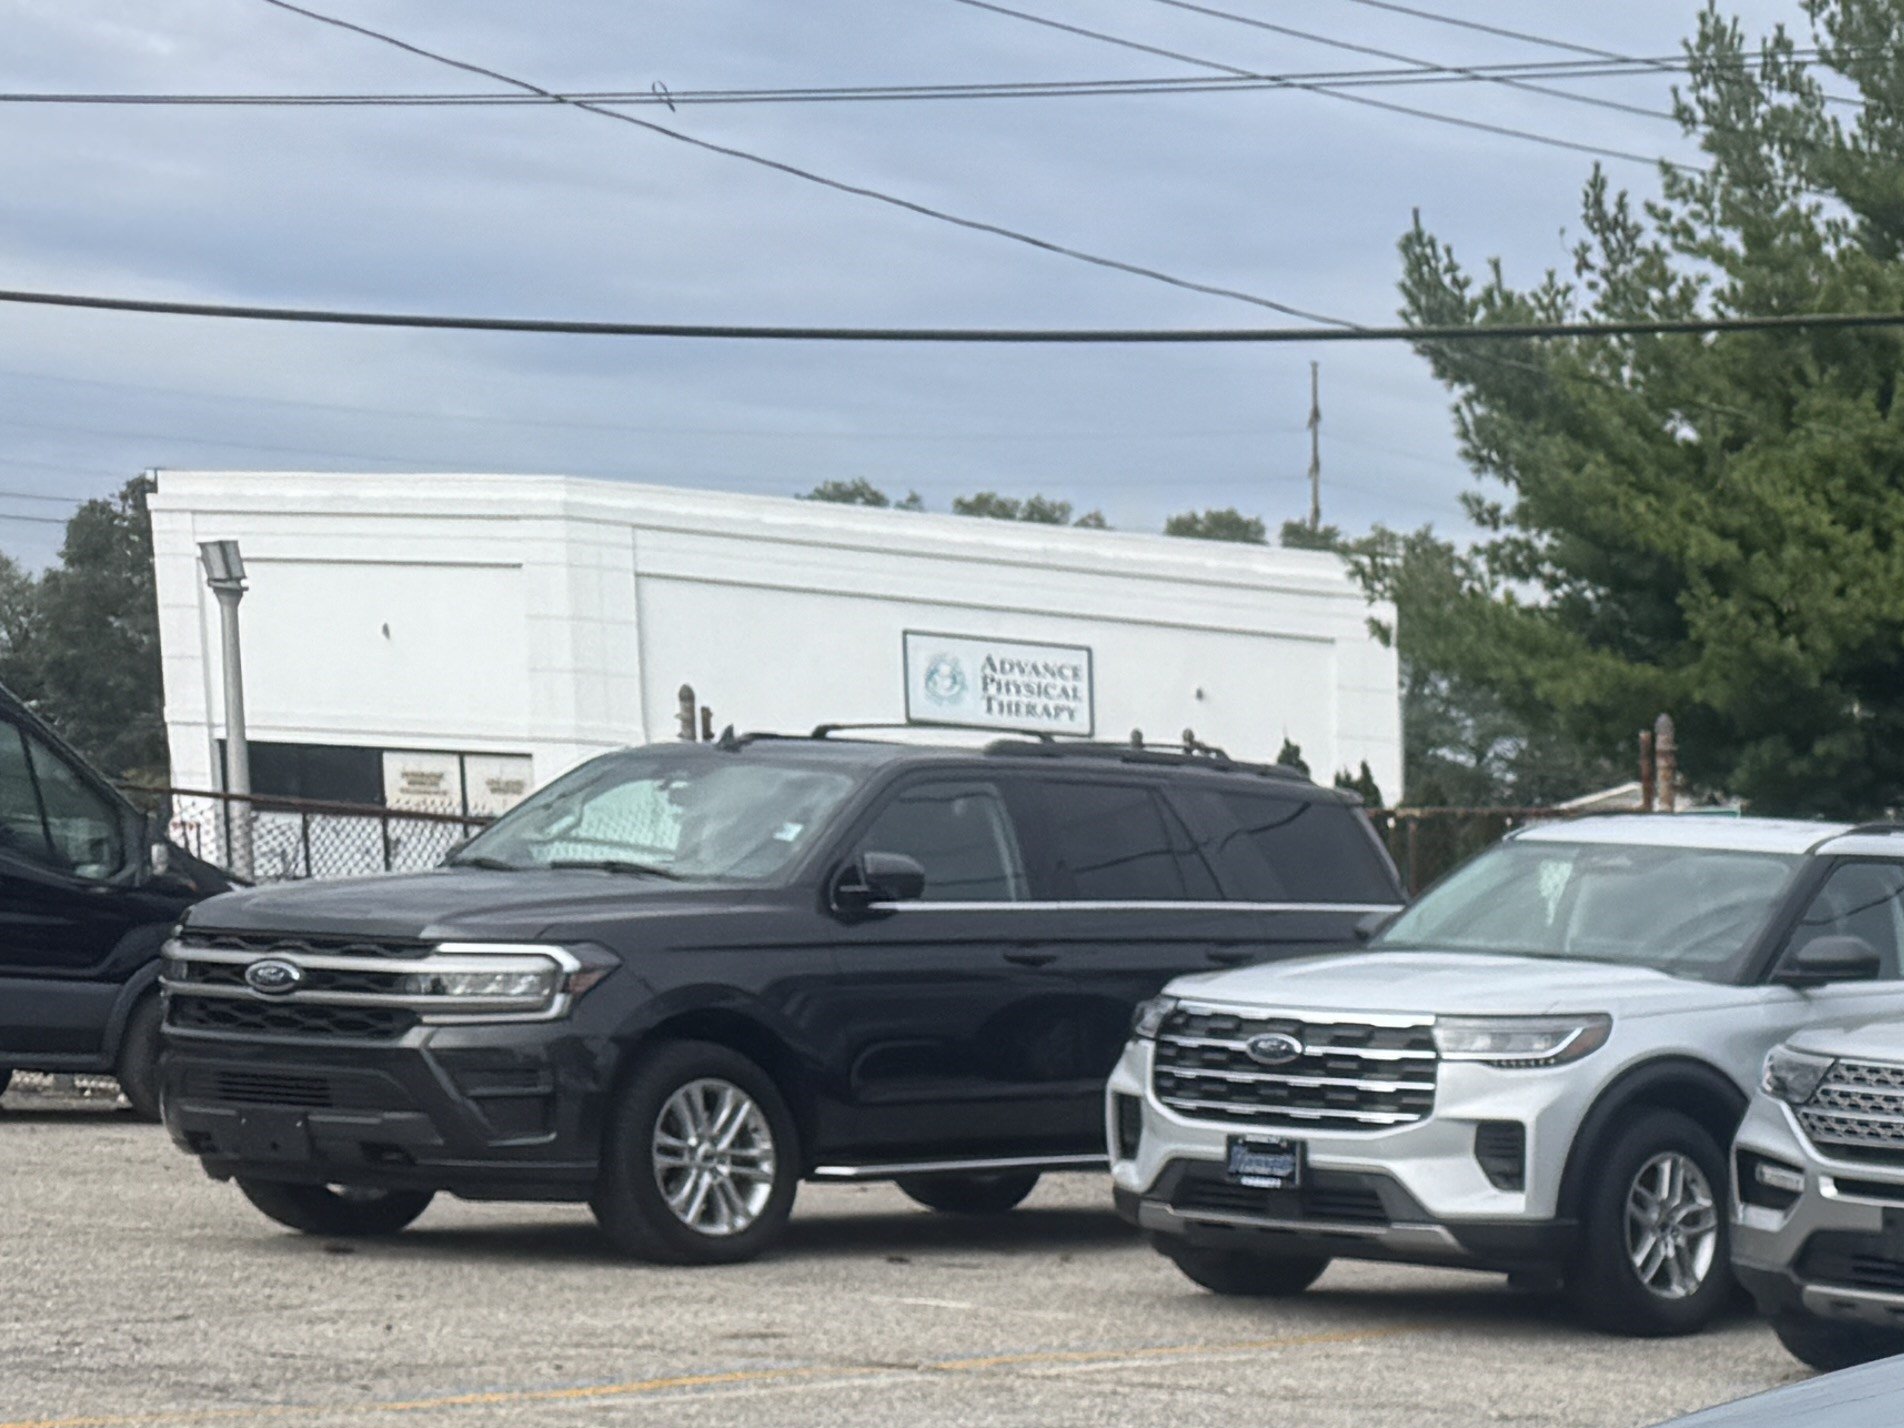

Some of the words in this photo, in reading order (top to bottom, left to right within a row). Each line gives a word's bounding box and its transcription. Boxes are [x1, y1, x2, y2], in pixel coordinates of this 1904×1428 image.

[981, 653, 1081, 682] ADVANCE
[981, 673, 1082, 701] PHYSICAL
[981, 695, 1077, 722] THERAPY
